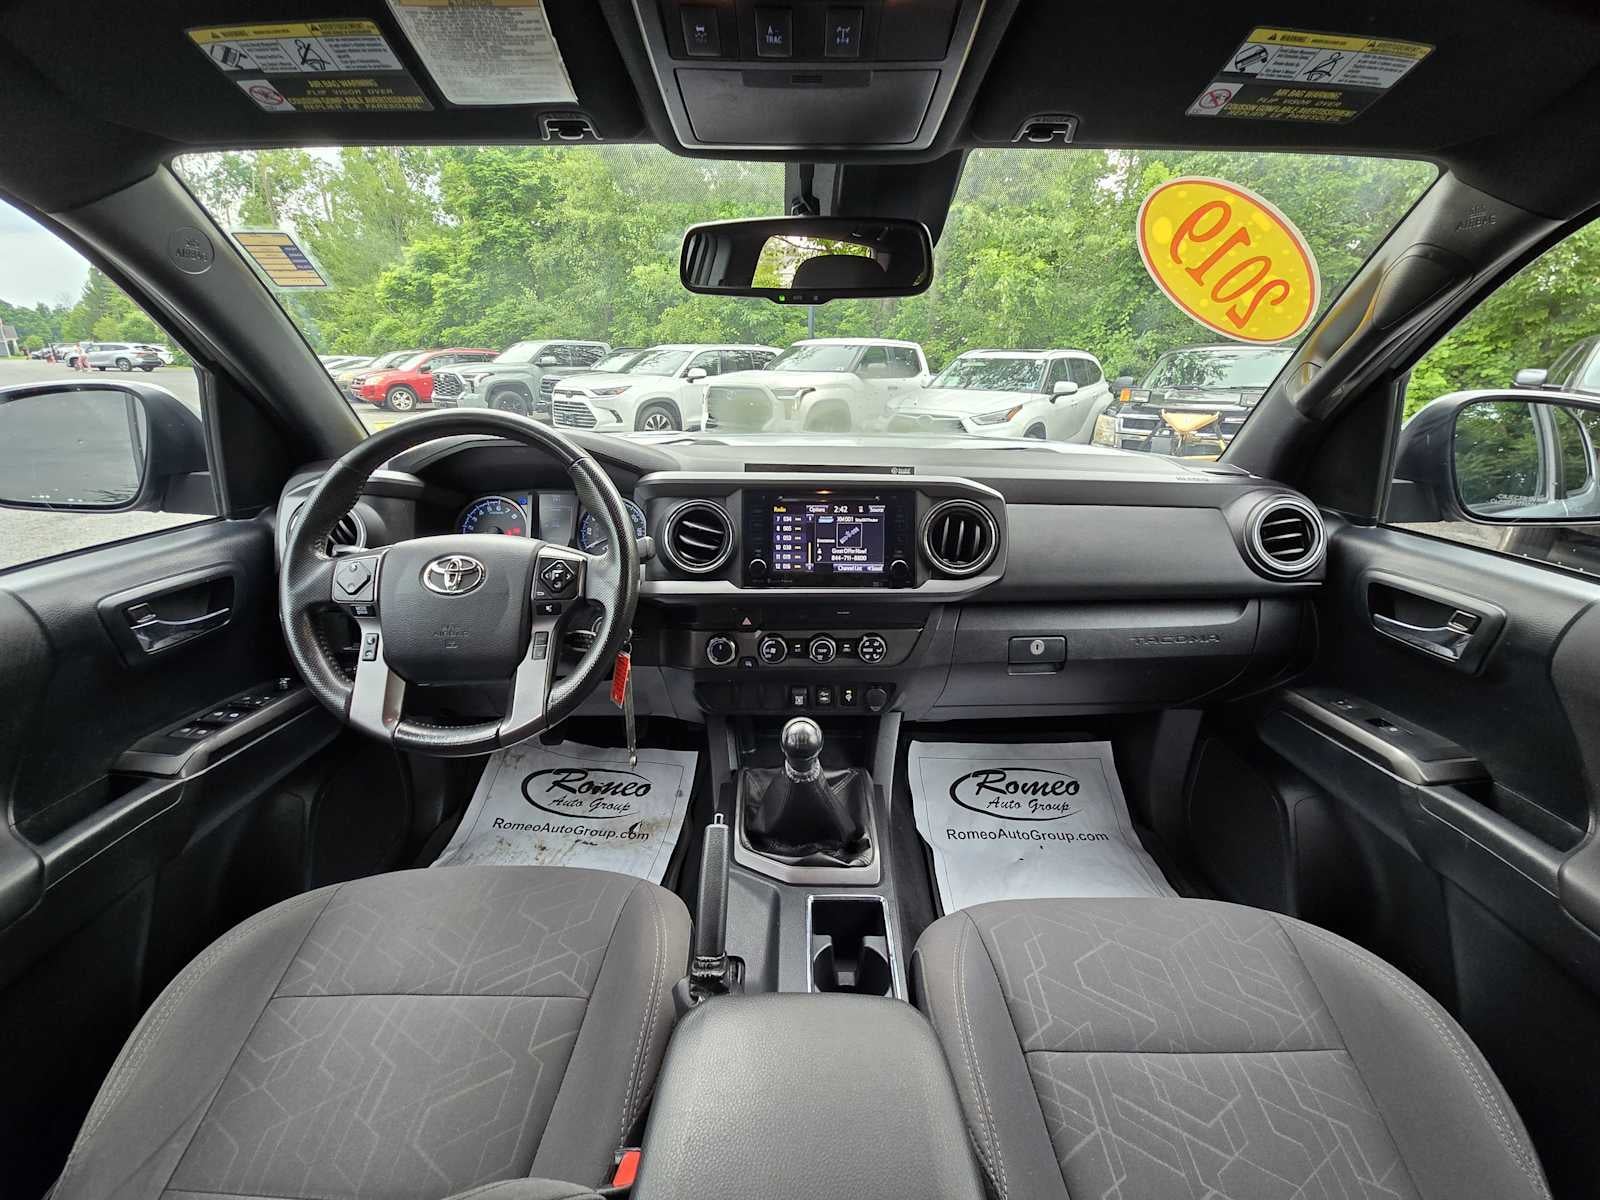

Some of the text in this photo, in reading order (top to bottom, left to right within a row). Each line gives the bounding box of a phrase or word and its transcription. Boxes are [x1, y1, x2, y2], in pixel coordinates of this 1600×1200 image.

[545, 768, 652, 797] Romeo
[972, 769, 1080, 796] Romeo
[549, 795, 631, 813] Auto Group
[986, 796, 1071, 813] Auto Group
[493, 817, 649, 840] RomeoAutoGroup.com
[946, 828, 1110, 843] RomeoAutoGroup.com
